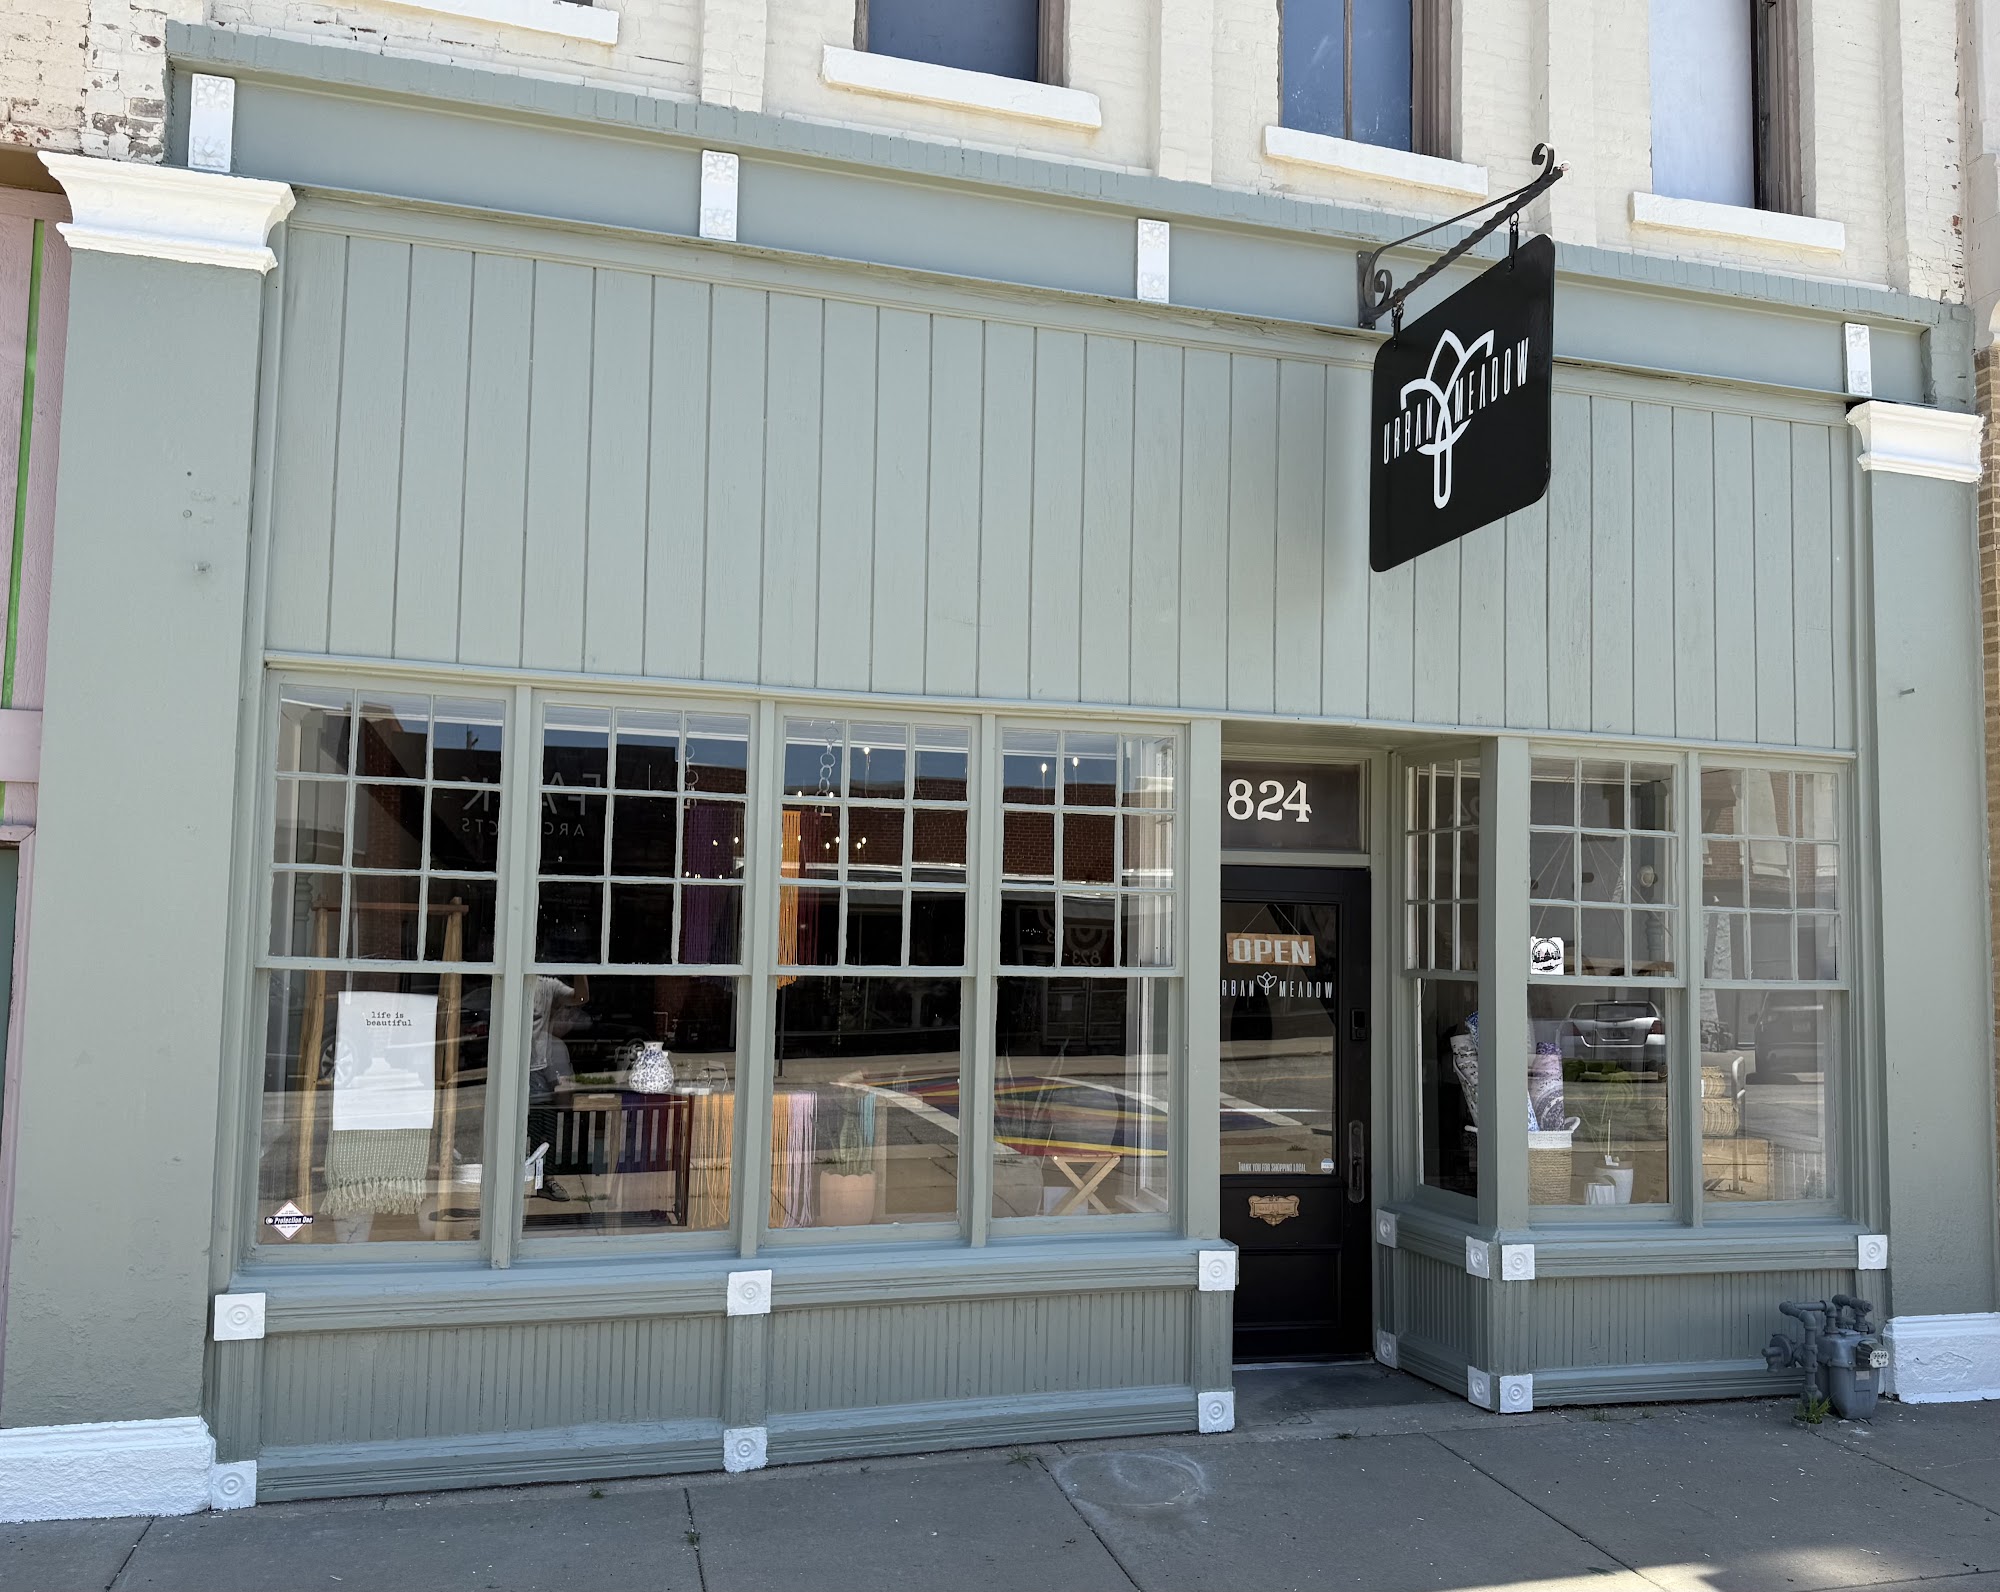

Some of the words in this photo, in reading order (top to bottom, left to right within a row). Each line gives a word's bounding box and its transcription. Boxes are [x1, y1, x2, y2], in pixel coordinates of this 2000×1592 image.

[1383, 396, 1434, 465] URBAN
[1454, 337, 1529, 424] MEADOW
[1227, 779, 1312, 822] 824
[1233, 939, 1310, 964] OPEN
[1221, 980, 1255, 997] RBAN
[1279, 981, 1333, 998] MEADOW
